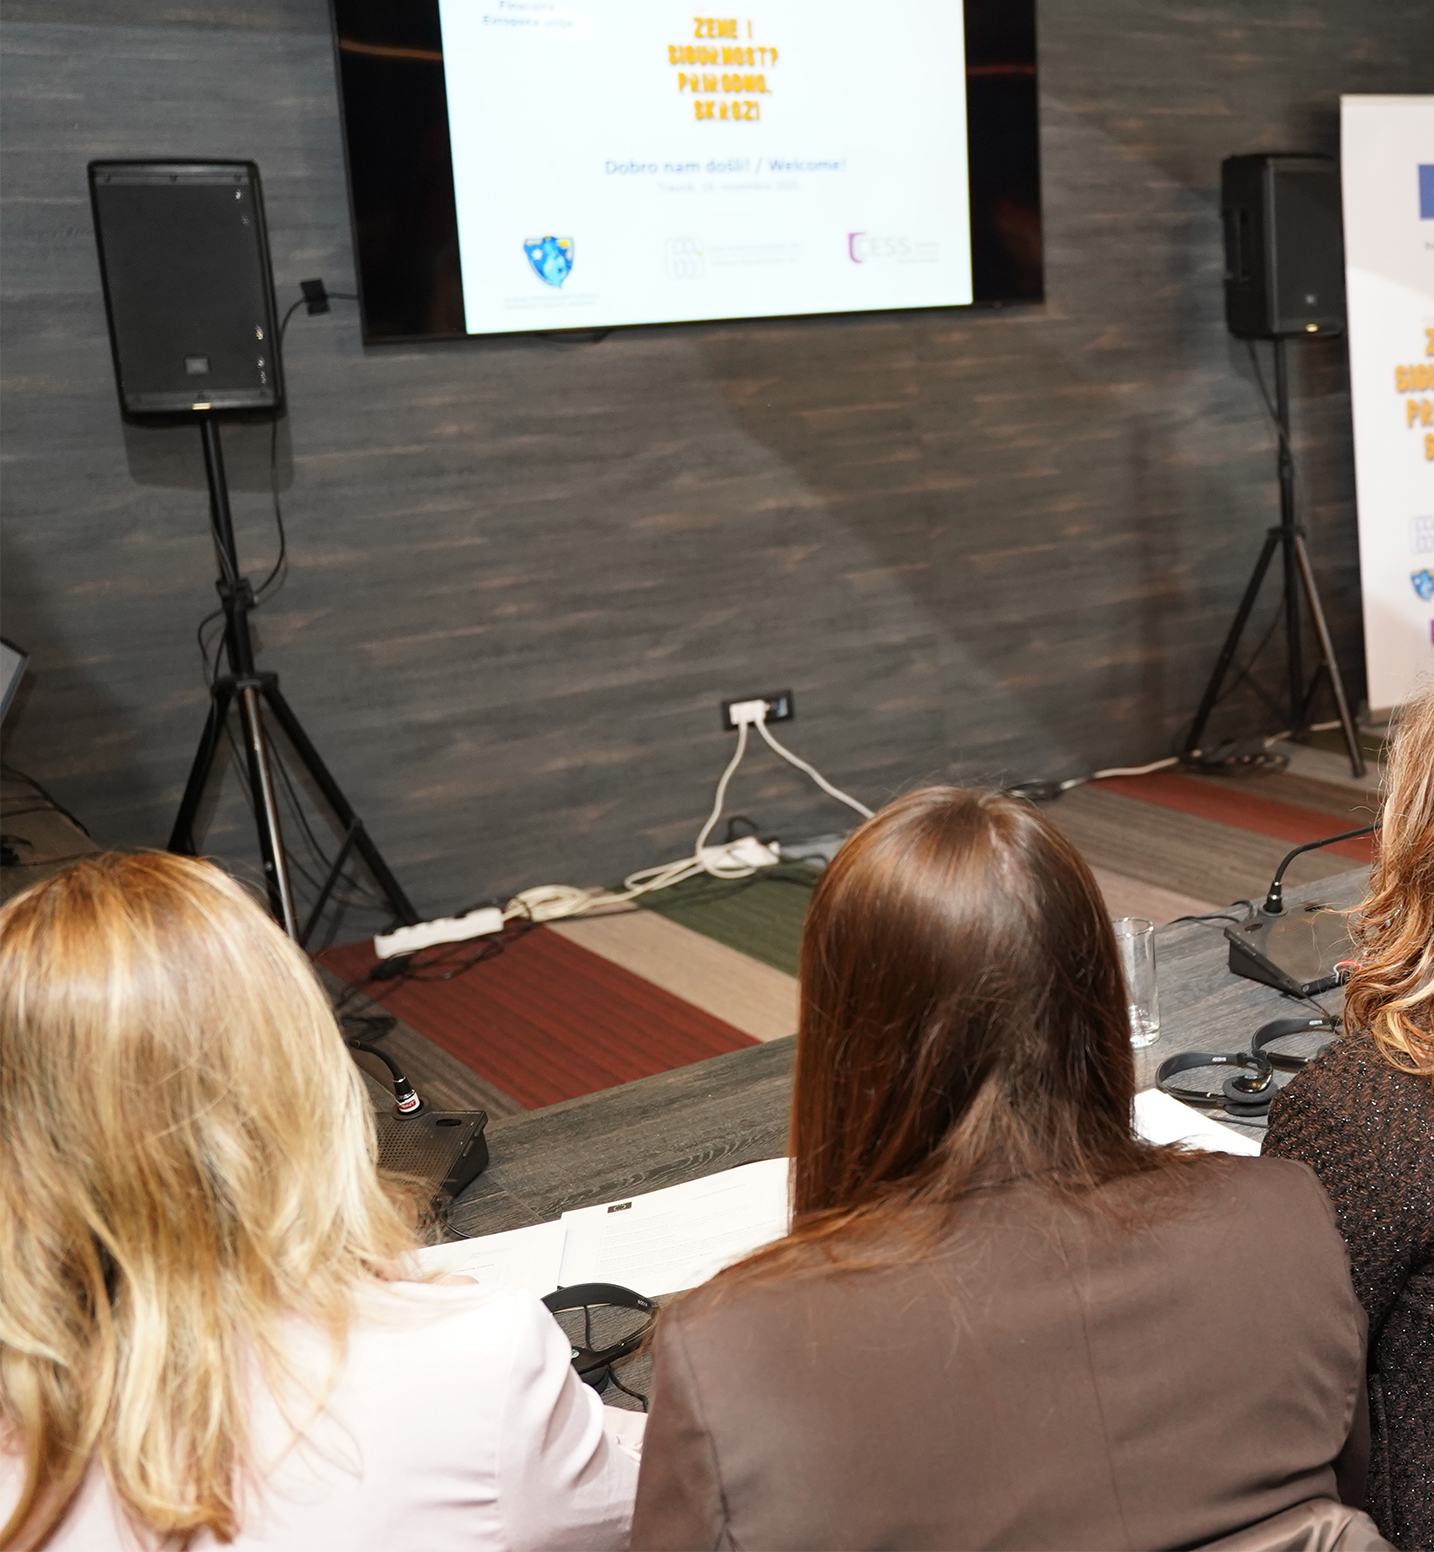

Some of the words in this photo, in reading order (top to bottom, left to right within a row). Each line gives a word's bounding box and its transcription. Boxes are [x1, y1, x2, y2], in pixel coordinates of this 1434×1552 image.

[667, 44, 778, 67] SIGURNOST?
[605, 159, 659, 175] Dobro
[663, 160, 700, 174] nam
[768, 157, 846, 172] Welcome!
